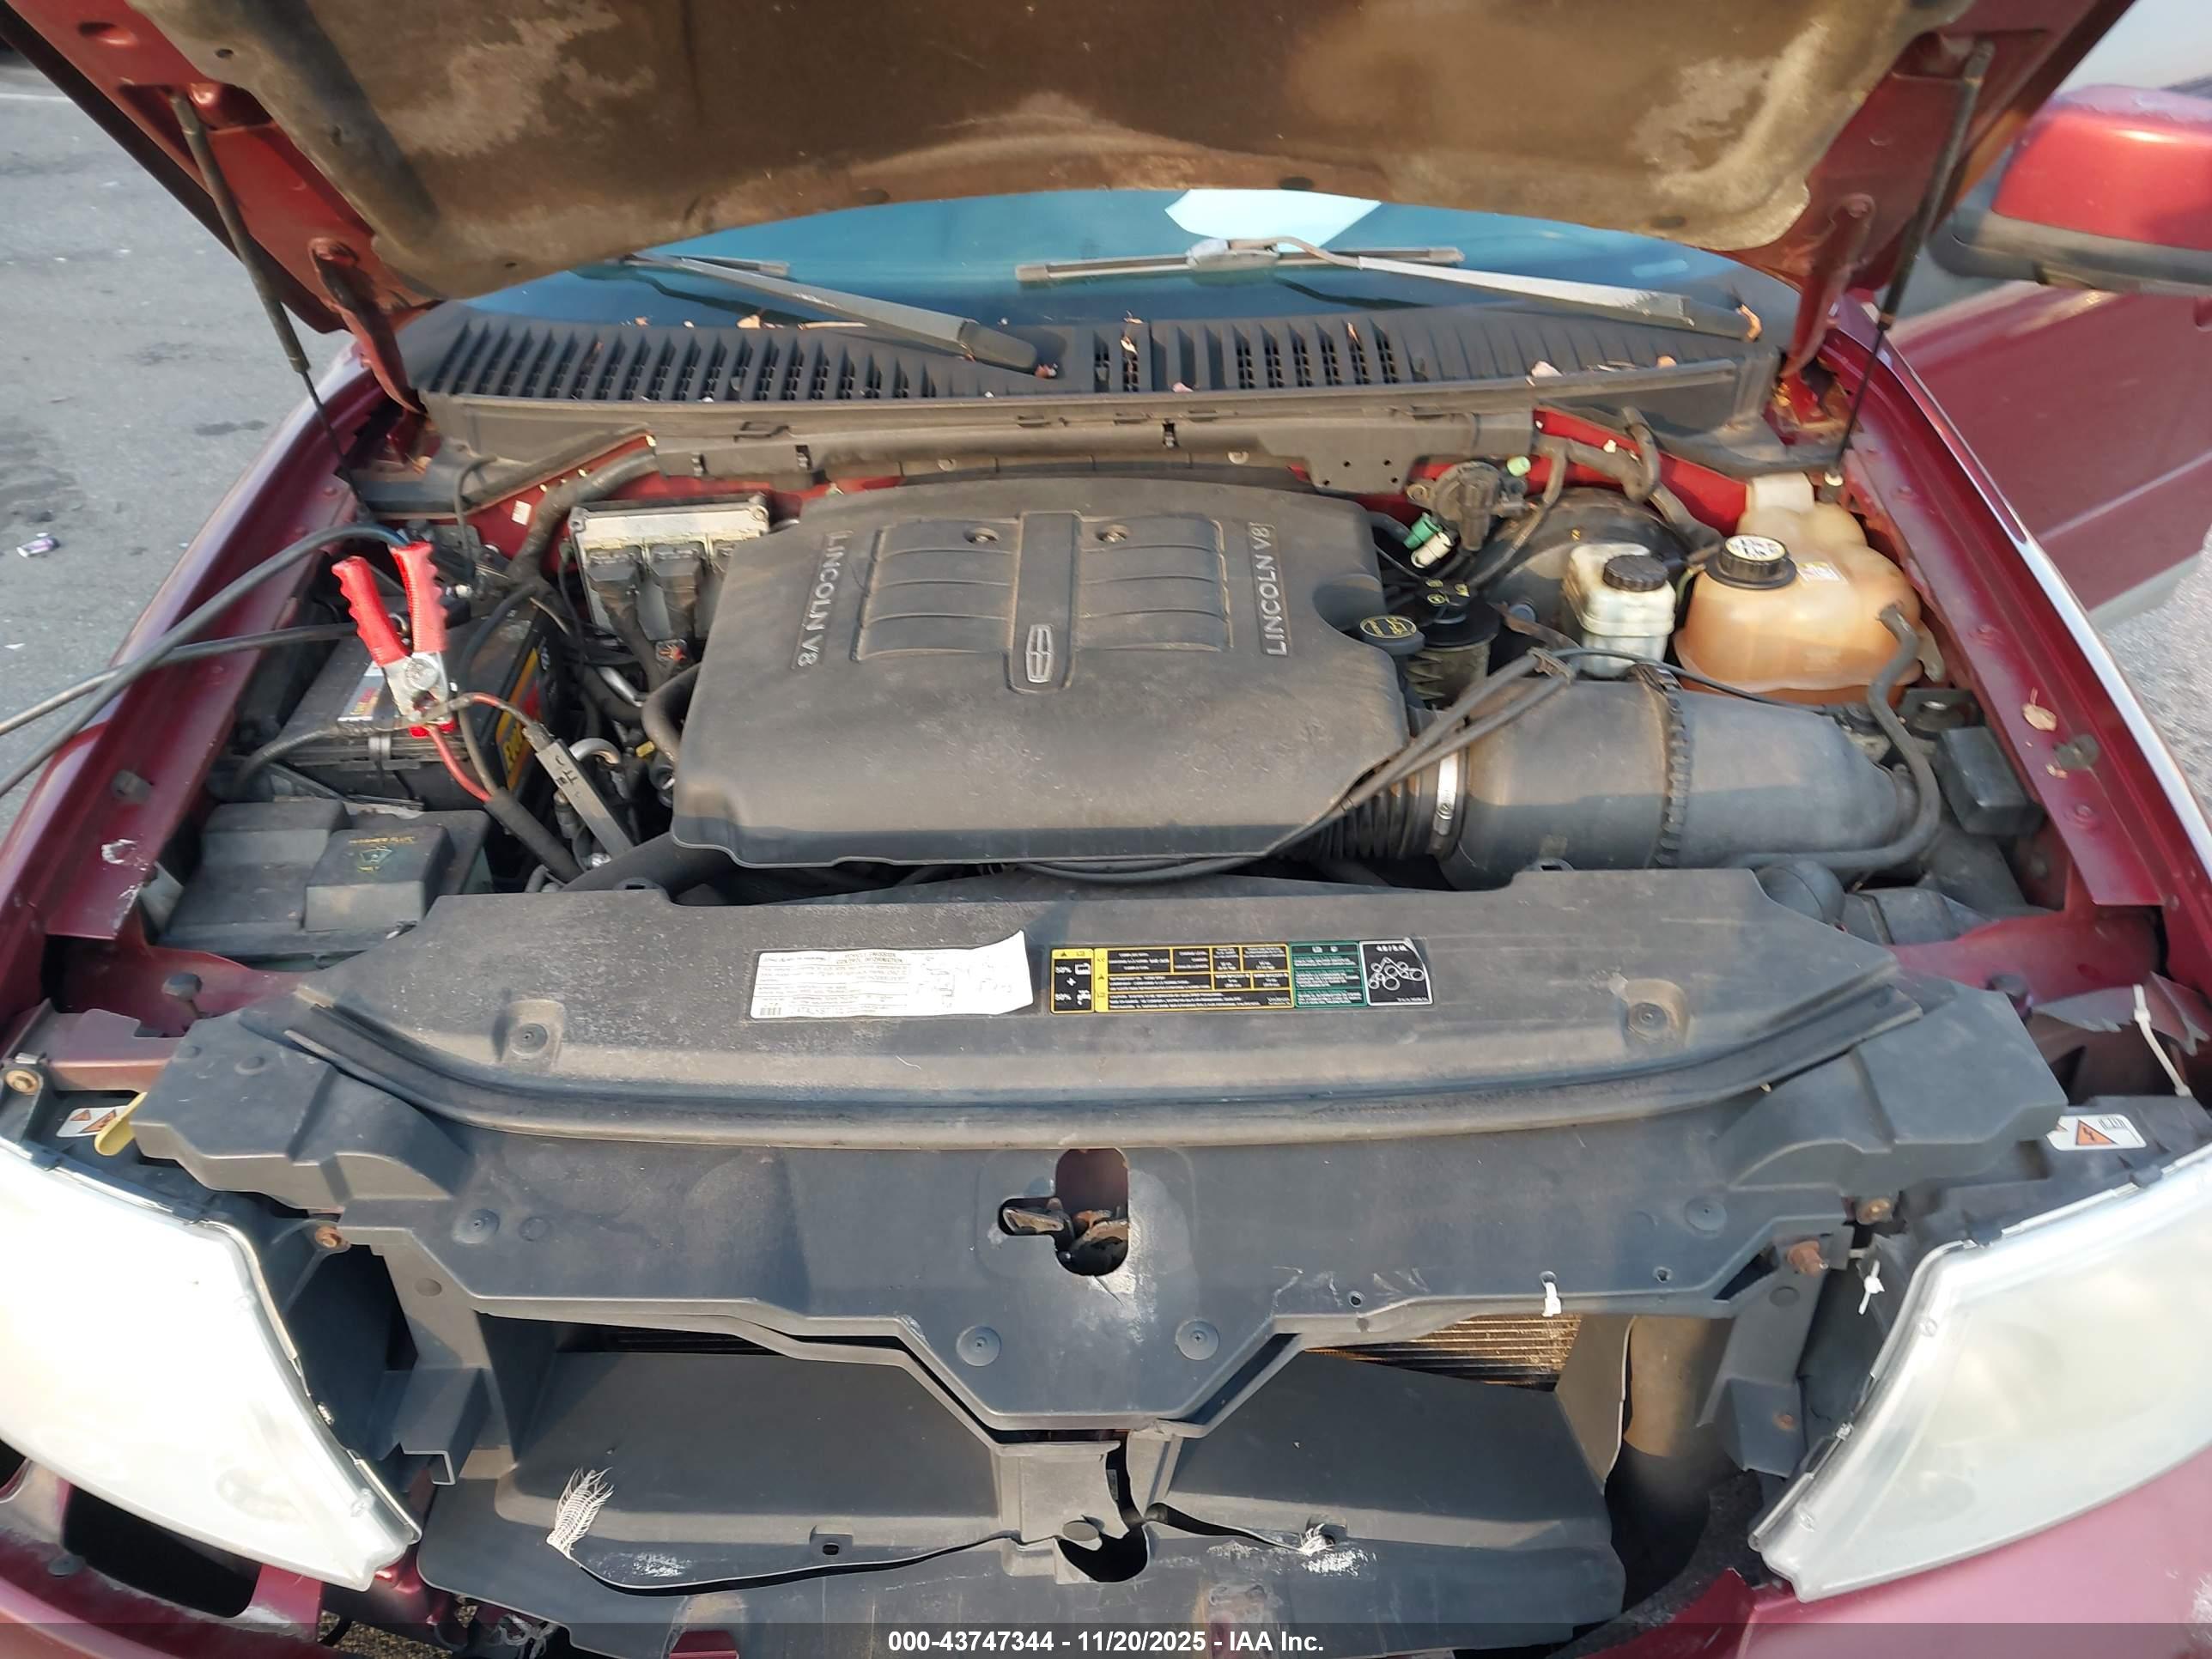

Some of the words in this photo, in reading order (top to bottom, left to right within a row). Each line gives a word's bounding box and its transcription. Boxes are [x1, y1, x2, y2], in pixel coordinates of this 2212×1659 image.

[1250, 526, 1272, 550] V8
[805, 531, 854, 631] LINCOLN
[1254, 554, 1288, 656] LINCOLN
[797, 635, 823, 666] V8
